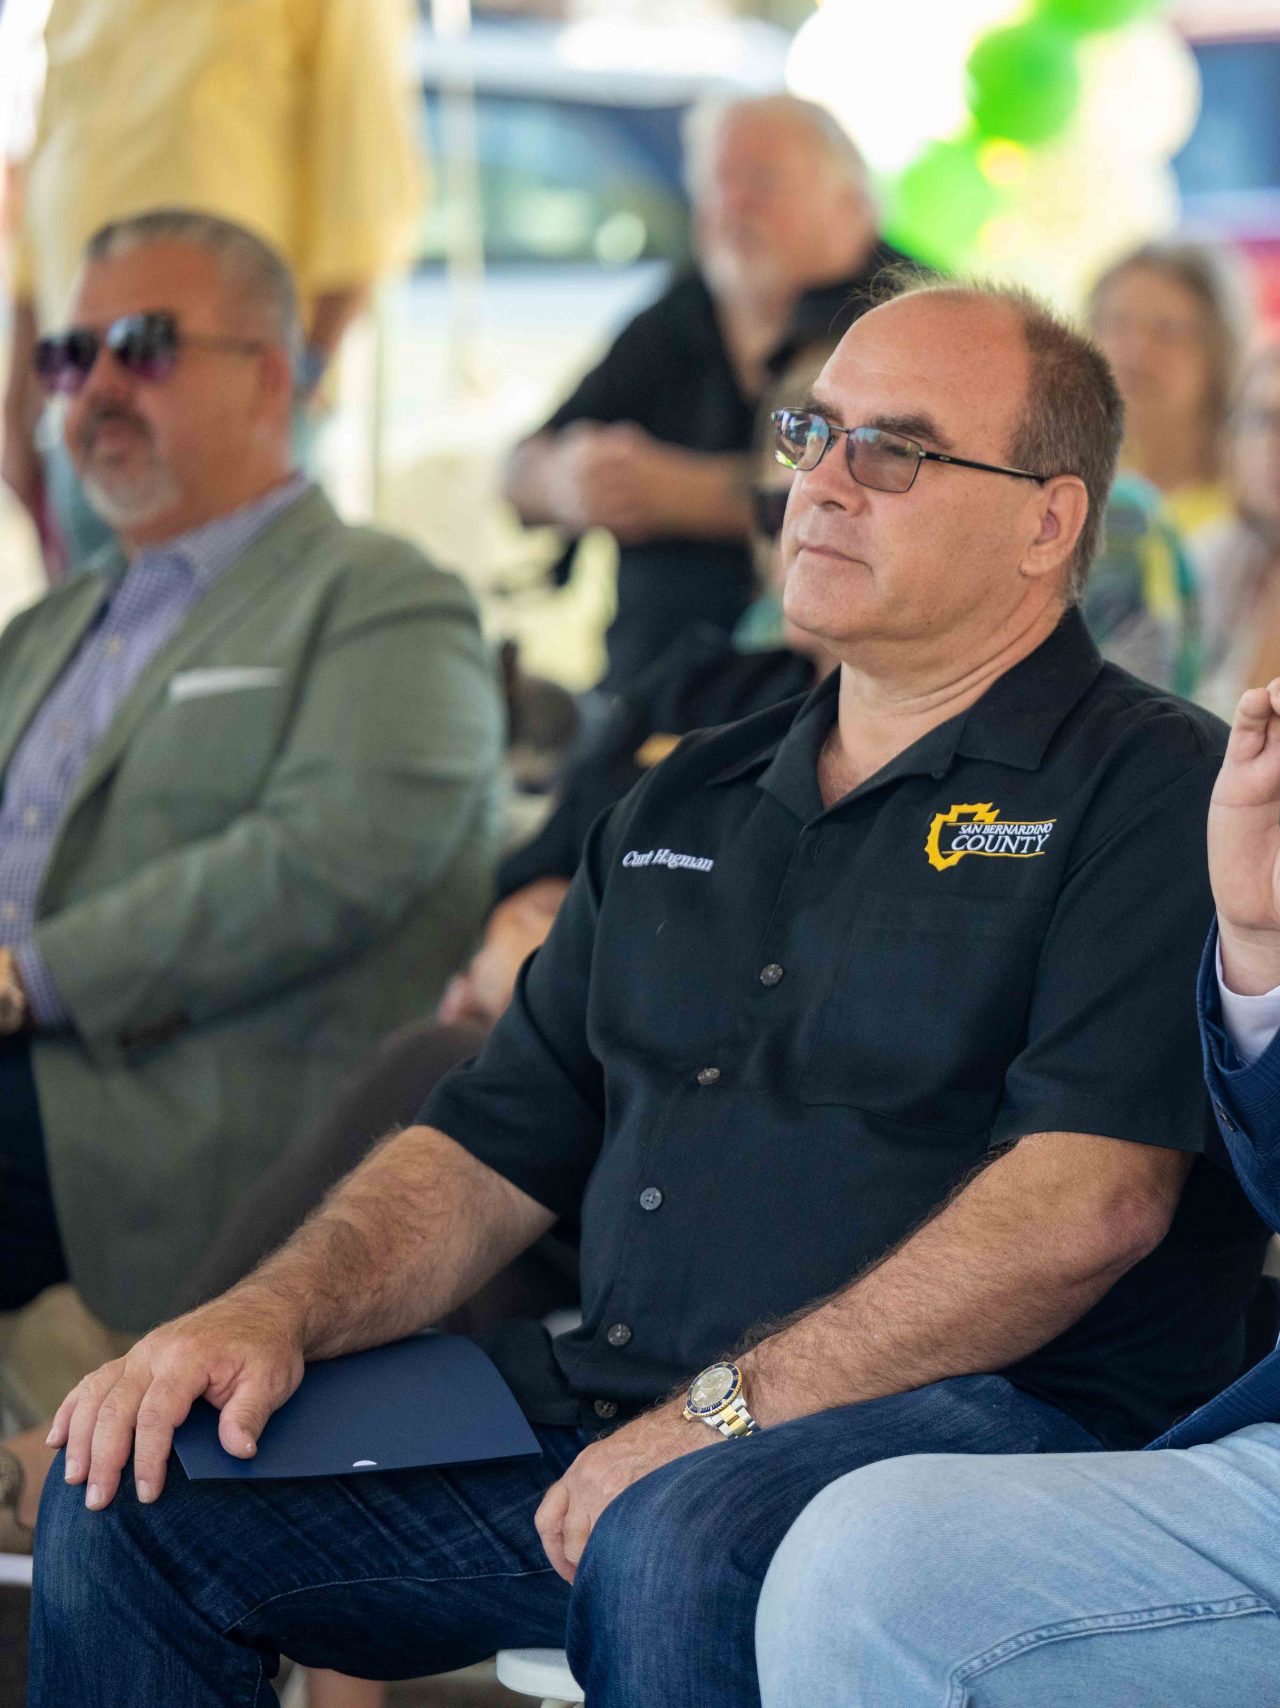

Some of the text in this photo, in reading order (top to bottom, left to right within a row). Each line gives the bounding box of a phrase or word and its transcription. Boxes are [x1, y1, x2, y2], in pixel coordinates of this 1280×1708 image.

[959, 823, 1053, 835] SAN BERNARDINO
[951, 834, 1050, 853] COUNTY
[622, 848, 714, 872] Curt Hagman
